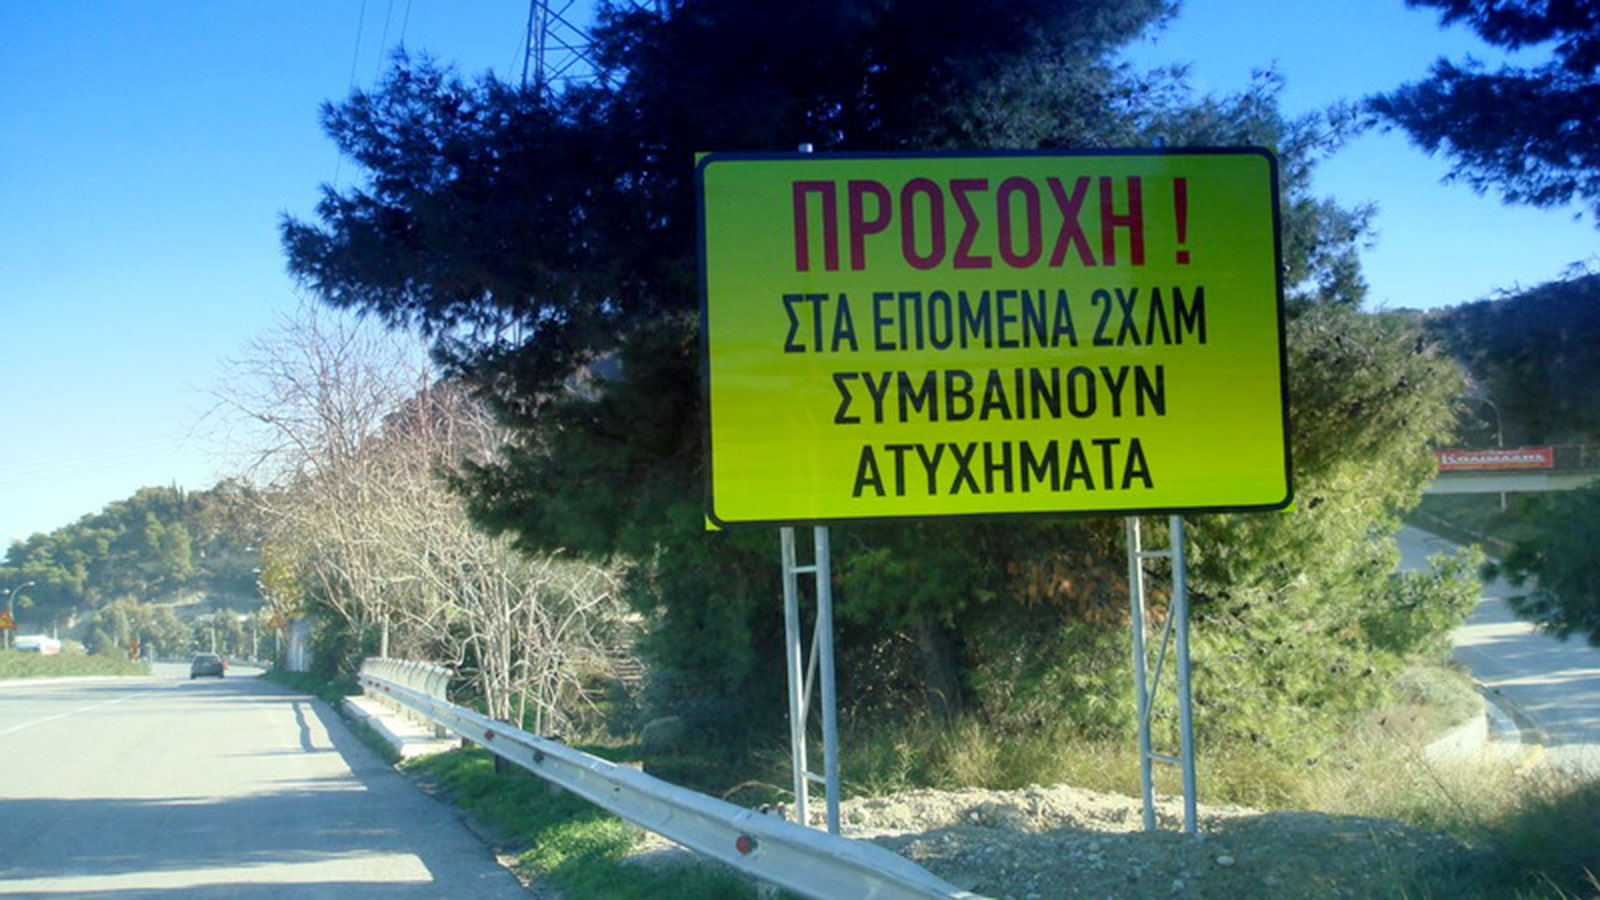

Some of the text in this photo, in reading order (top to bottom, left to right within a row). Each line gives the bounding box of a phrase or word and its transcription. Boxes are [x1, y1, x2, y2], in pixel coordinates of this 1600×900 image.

[792, 176, 1190, 271] ΠΡΟΣΟΧΗ !
[781, 286, 1207, 353] ΣΤΑ ΕΠΟΜΕΝΑ 2ΧΛΜ
[833, 365, 1166, 424] ΣΥΜΒΑΙΝΟΥΝ
[852, 437, 1154, 498] ΑΤΥΧΗΜΑΤΑ
